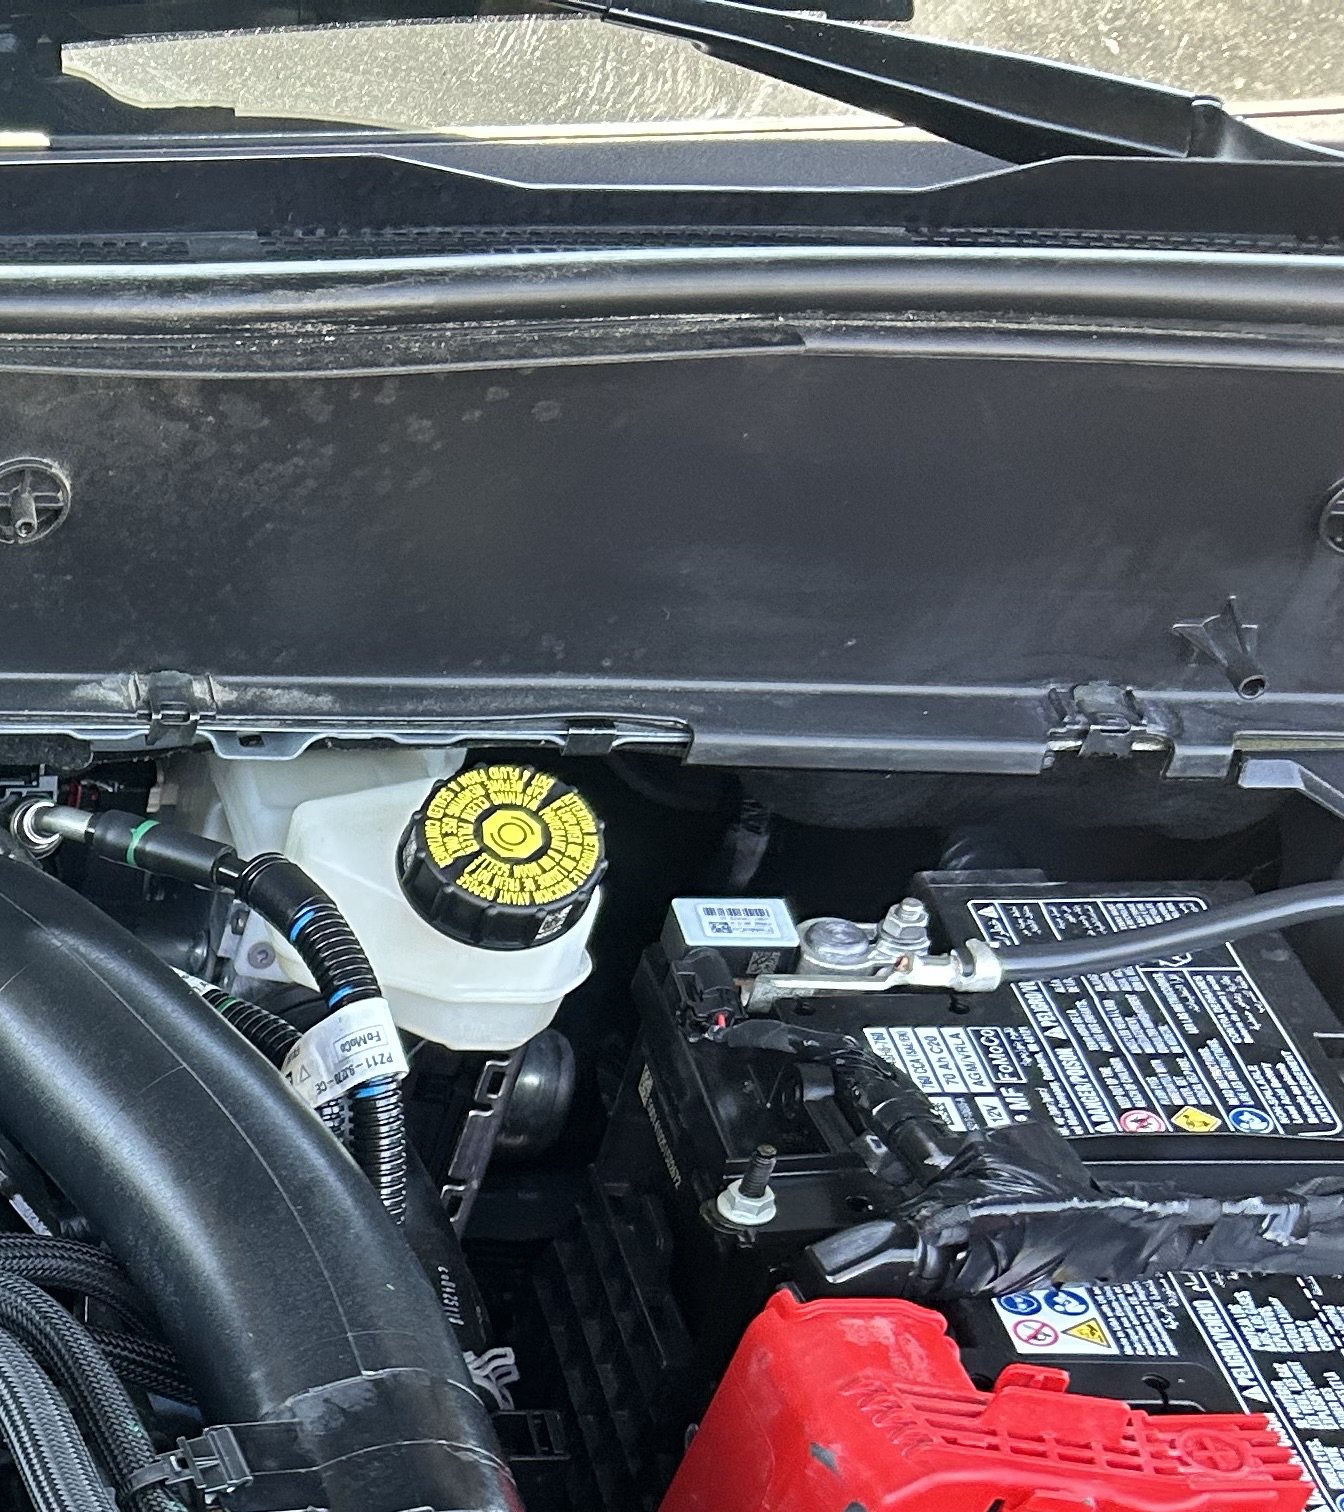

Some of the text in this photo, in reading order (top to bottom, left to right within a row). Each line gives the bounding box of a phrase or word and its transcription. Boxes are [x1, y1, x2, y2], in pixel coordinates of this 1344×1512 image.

[456, 769, 487, 787] FROM
[483, 779, 523, 793] BEFORE
[487, 767, 518, 779] FLUID
[531, 773, 555, 790] DOT
[426, 787, 455, 818] SEALED
[459, 795, 491, 822] CLEAN
[560, 790, 596, 832] ATTENTION
[426, 819, 454, 867] CONTAINER
[458, 821, 480, 854] FILLER
[491, 874, 520, 890] FREIN
[496, 889, 531, 904] AVANT
[340, 1031, 381, 1053] FoMoCo
[980, 1029, 1017, 1081] FoMoCo
[925, 1036, 959, 1086] 70 Ah C20
[949, 1033, 986, 1087] AGM/VRLA
[1000, 1087, 1031, 1110] MF
[1050, 1047, 1113, 1121] DANGER/POISON
[1246, 1065, 1291, 1123] NON-SPILLABLE
[983, 1104, 1004, 1122] 12V
[1193, 1299, 1260, 1386] PELIGRO/VENENO
